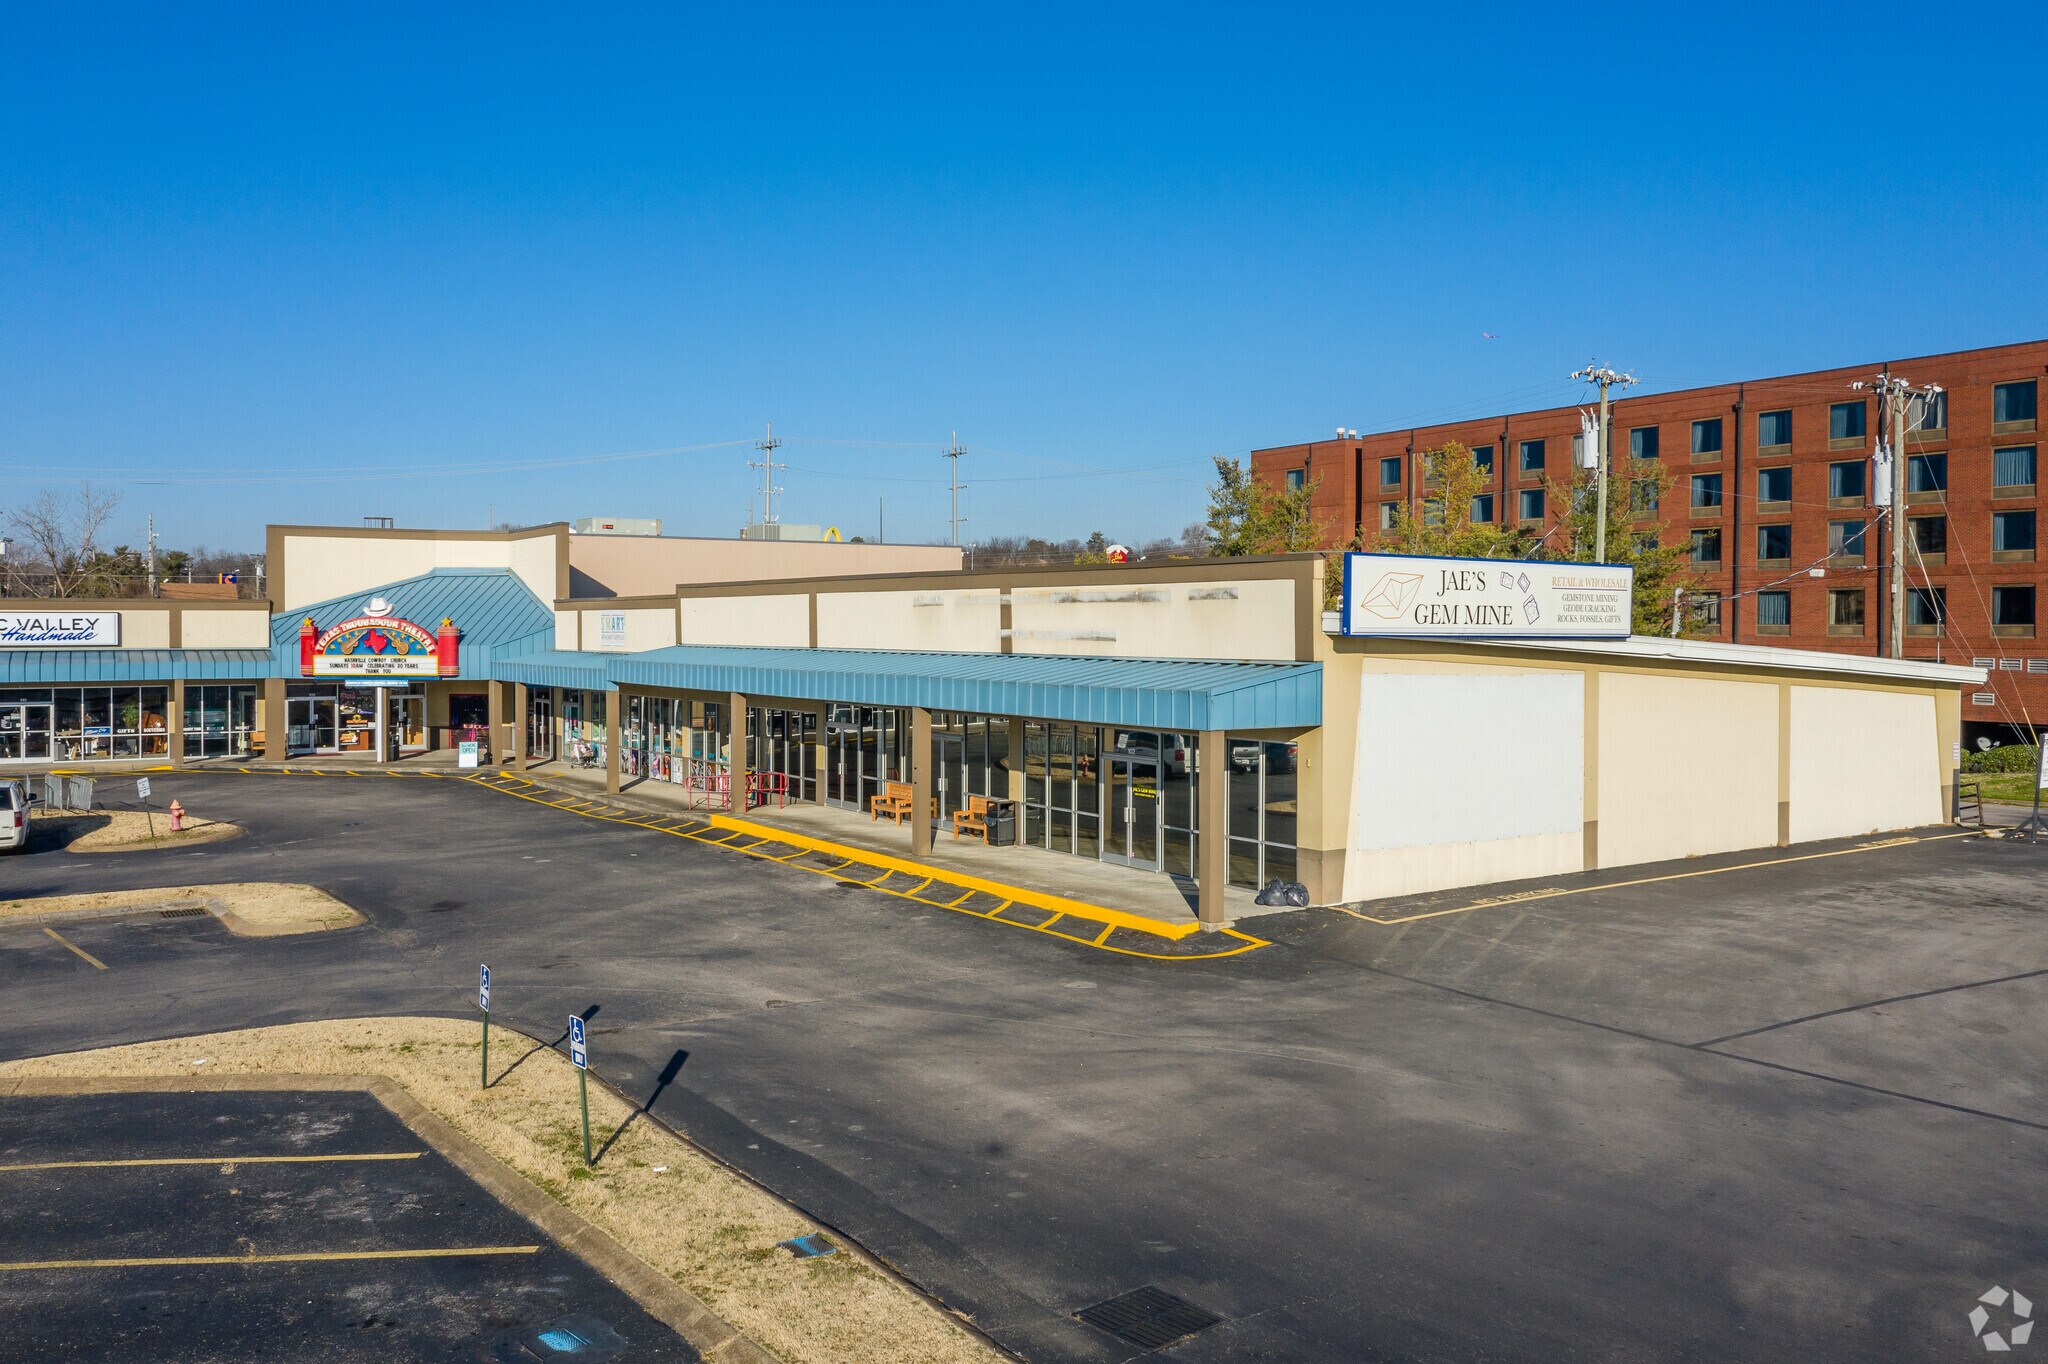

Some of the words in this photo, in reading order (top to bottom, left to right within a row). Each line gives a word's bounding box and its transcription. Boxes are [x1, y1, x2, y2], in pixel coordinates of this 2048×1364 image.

[1436, 569, 1486, 597] JAE'S
[1552, 576, 1577, 587] RETAIL
[1579, 578, 1584, 587] &
[1585, 578, 1628, 588] WHOLESALE
[1561, 594, 1595, 602] GEMSTONE
[1595, 595, 1618, 603] MINING
[1414, 603, 1459, 625] GEM
[1464, 604, 1513, 626] MINE
[1563, 604, 1584, 612] GEODE
[1584, 604, 1617, 613] CRACKING
[16, 618, 100, 631] VALLEY
[1557, 614, 1579, 623] ROCKS,
[1579, 615, 1604, 624] FOSSILS,
[1604, 616, 1622, 624] GIFTS
[1, 625, 98, 641] Handmade
[315, 626, 341, 651] TEXAS
[340, 618, 399, 632] TROUBADOUR
[400, 621, 436, 653] THEATRE
